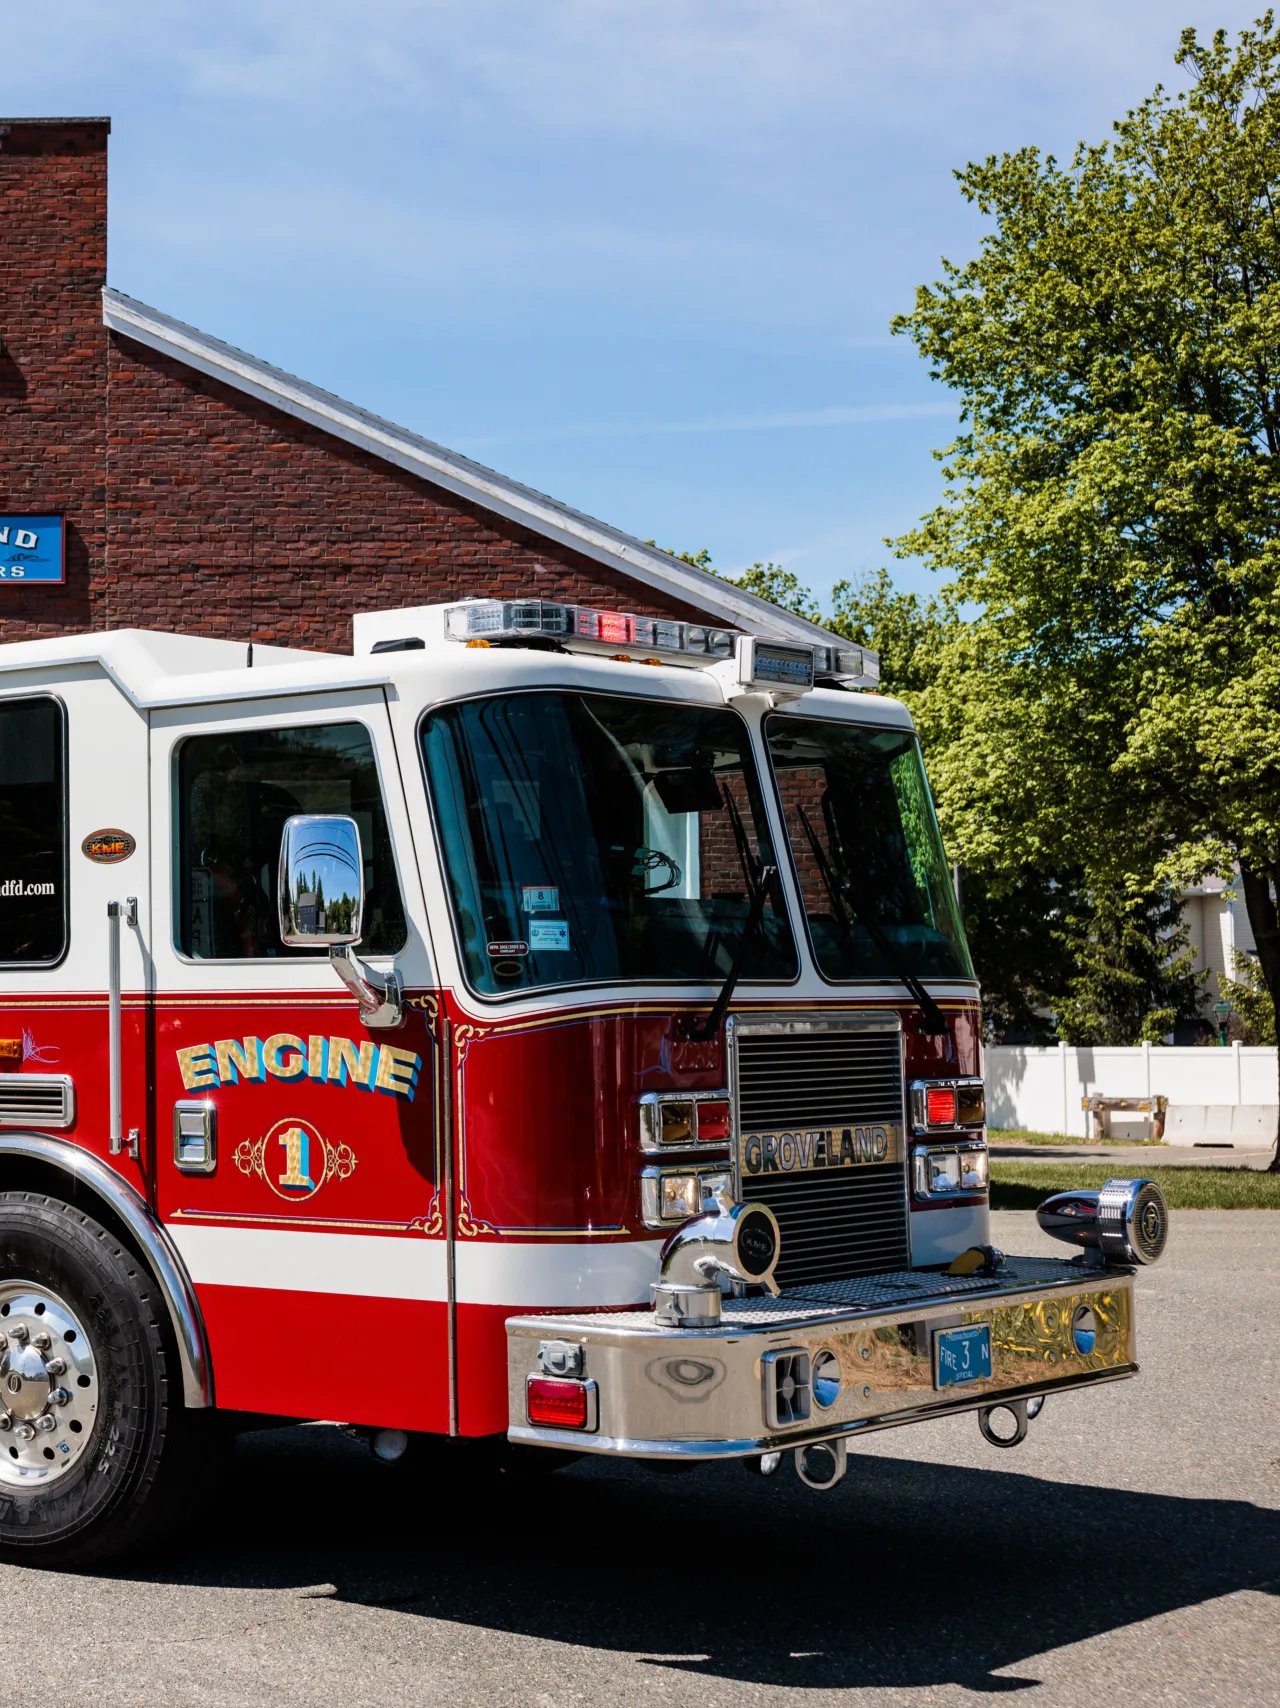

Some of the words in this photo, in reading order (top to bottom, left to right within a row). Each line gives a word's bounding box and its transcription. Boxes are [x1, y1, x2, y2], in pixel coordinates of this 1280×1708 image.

[92, 842, 125, 854] KME
[537, 891, 544, 900] 8
[175, 1033, 423, 1102] ENGINE
[279, 1127, 315, 1191] 1
[744, 1126, 888, 1174] GROVELAND
[940, 1345, 958, 1371] FIRE
[961, 1340, 970, 1369] 3
[981, 1343, 989, 1360] N
